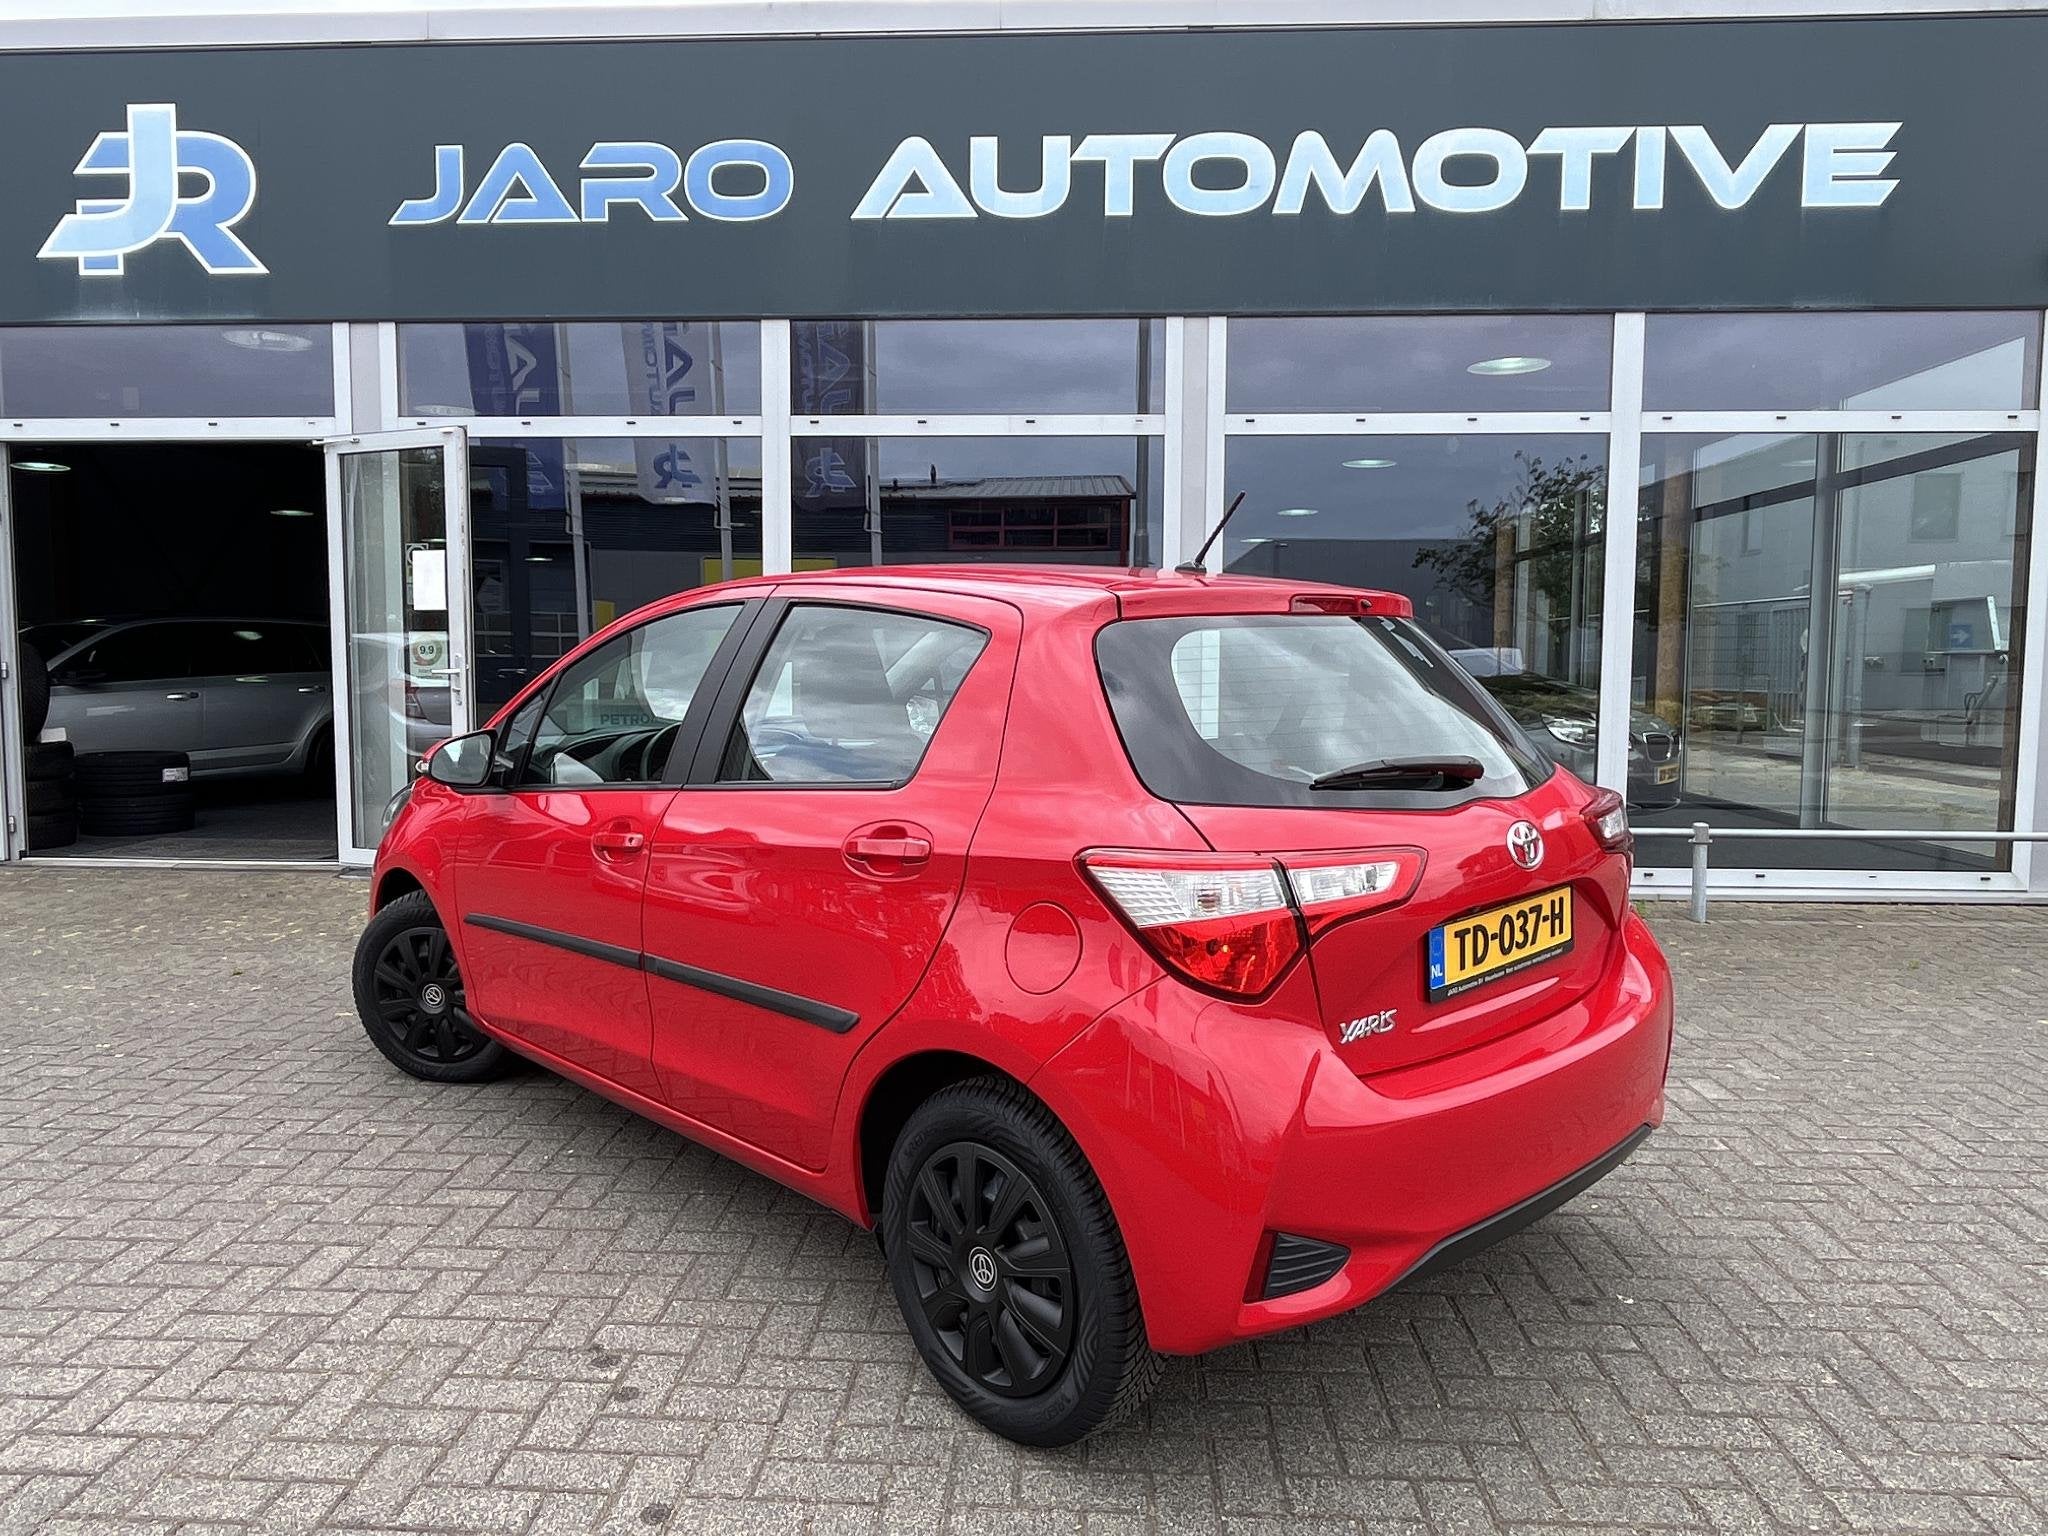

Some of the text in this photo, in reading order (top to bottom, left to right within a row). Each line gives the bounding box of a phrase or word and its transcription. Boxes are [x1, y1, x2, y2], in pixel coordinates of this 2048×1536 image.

[388, 120, 1904, 226] JARO AUTOMOTIVE
[600, 712, 654, 725] PETRO
[1454, 896, 1565, 972] TD-037-H
[1431, 963, 1444, 980] NL
[1339, 1008, 1398, 1045] YARIS
